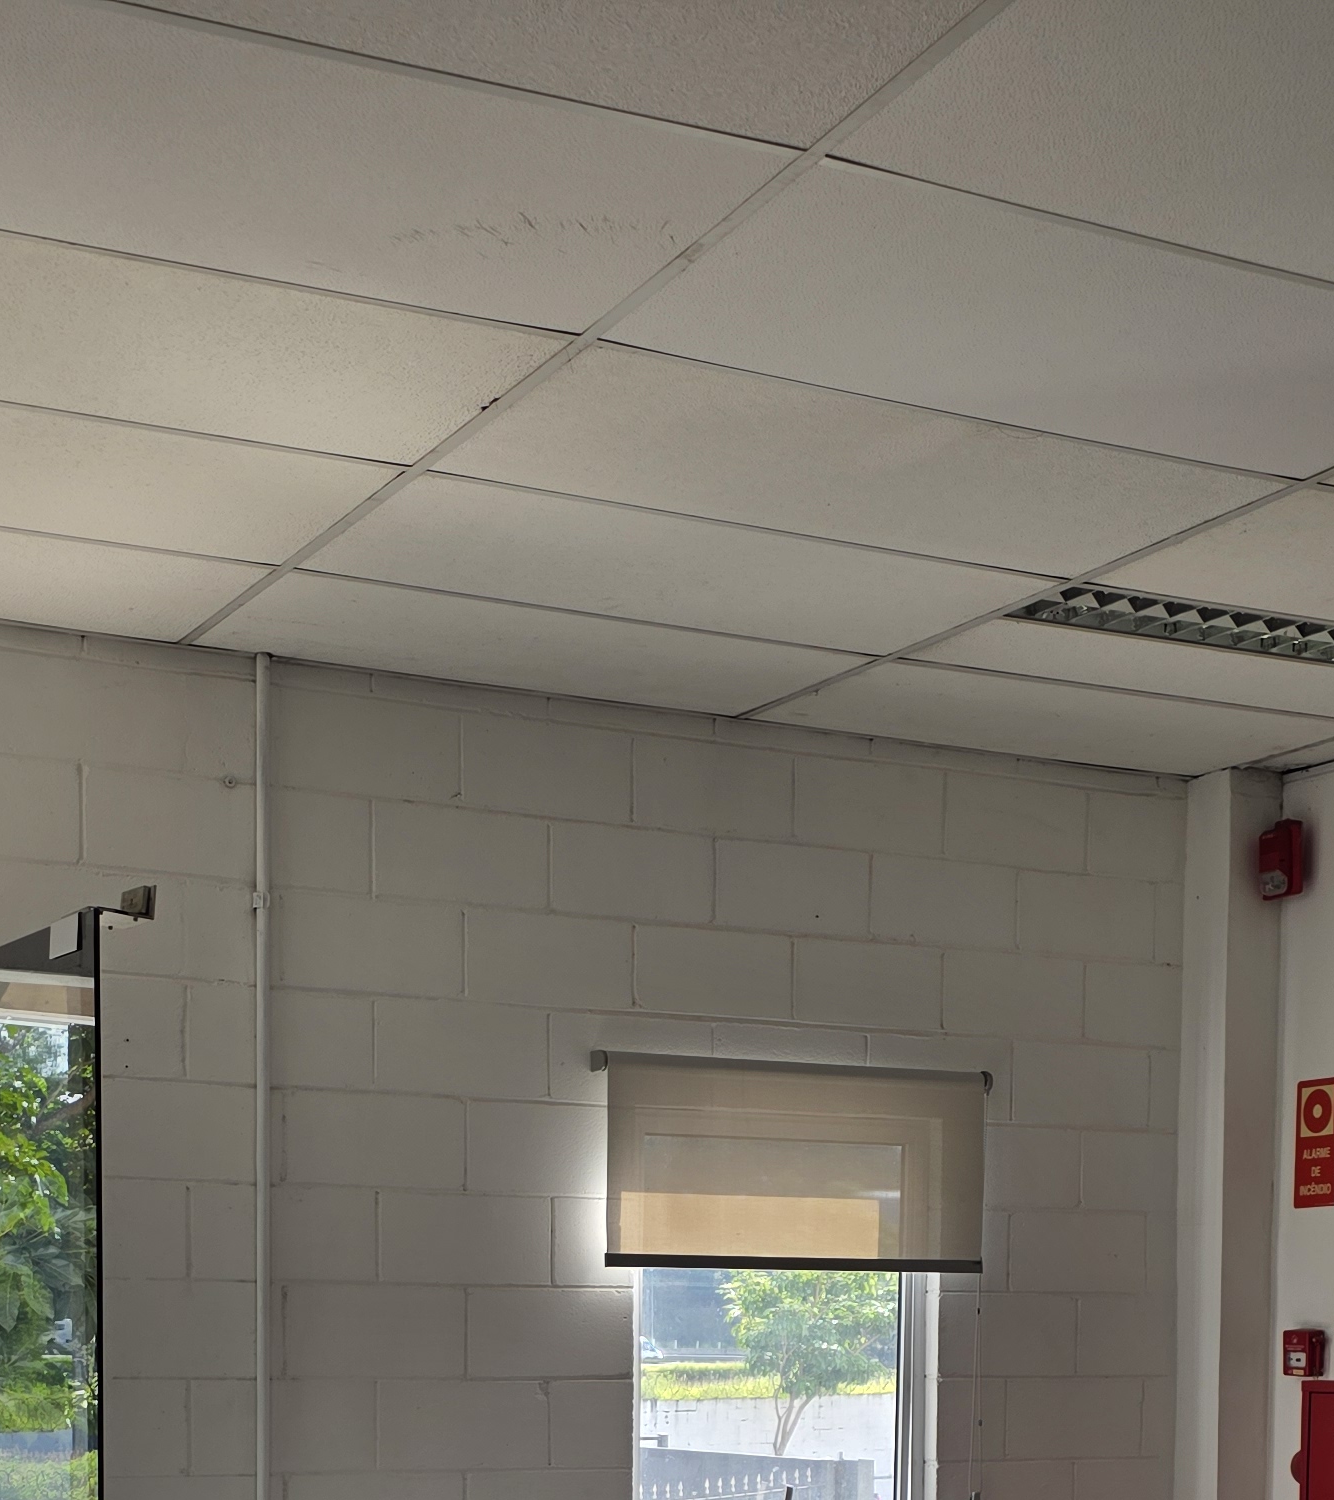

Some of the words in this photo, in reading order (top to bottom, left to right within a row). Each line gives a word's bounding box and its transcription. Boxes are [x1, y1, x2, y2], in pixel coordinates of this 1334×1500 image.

[1302, 1147, 1331, 1159] ALARME
[1311, 1166, 1321, 1177] DE
[1299, 1182, 1332, 1196] INCÊNDIO
